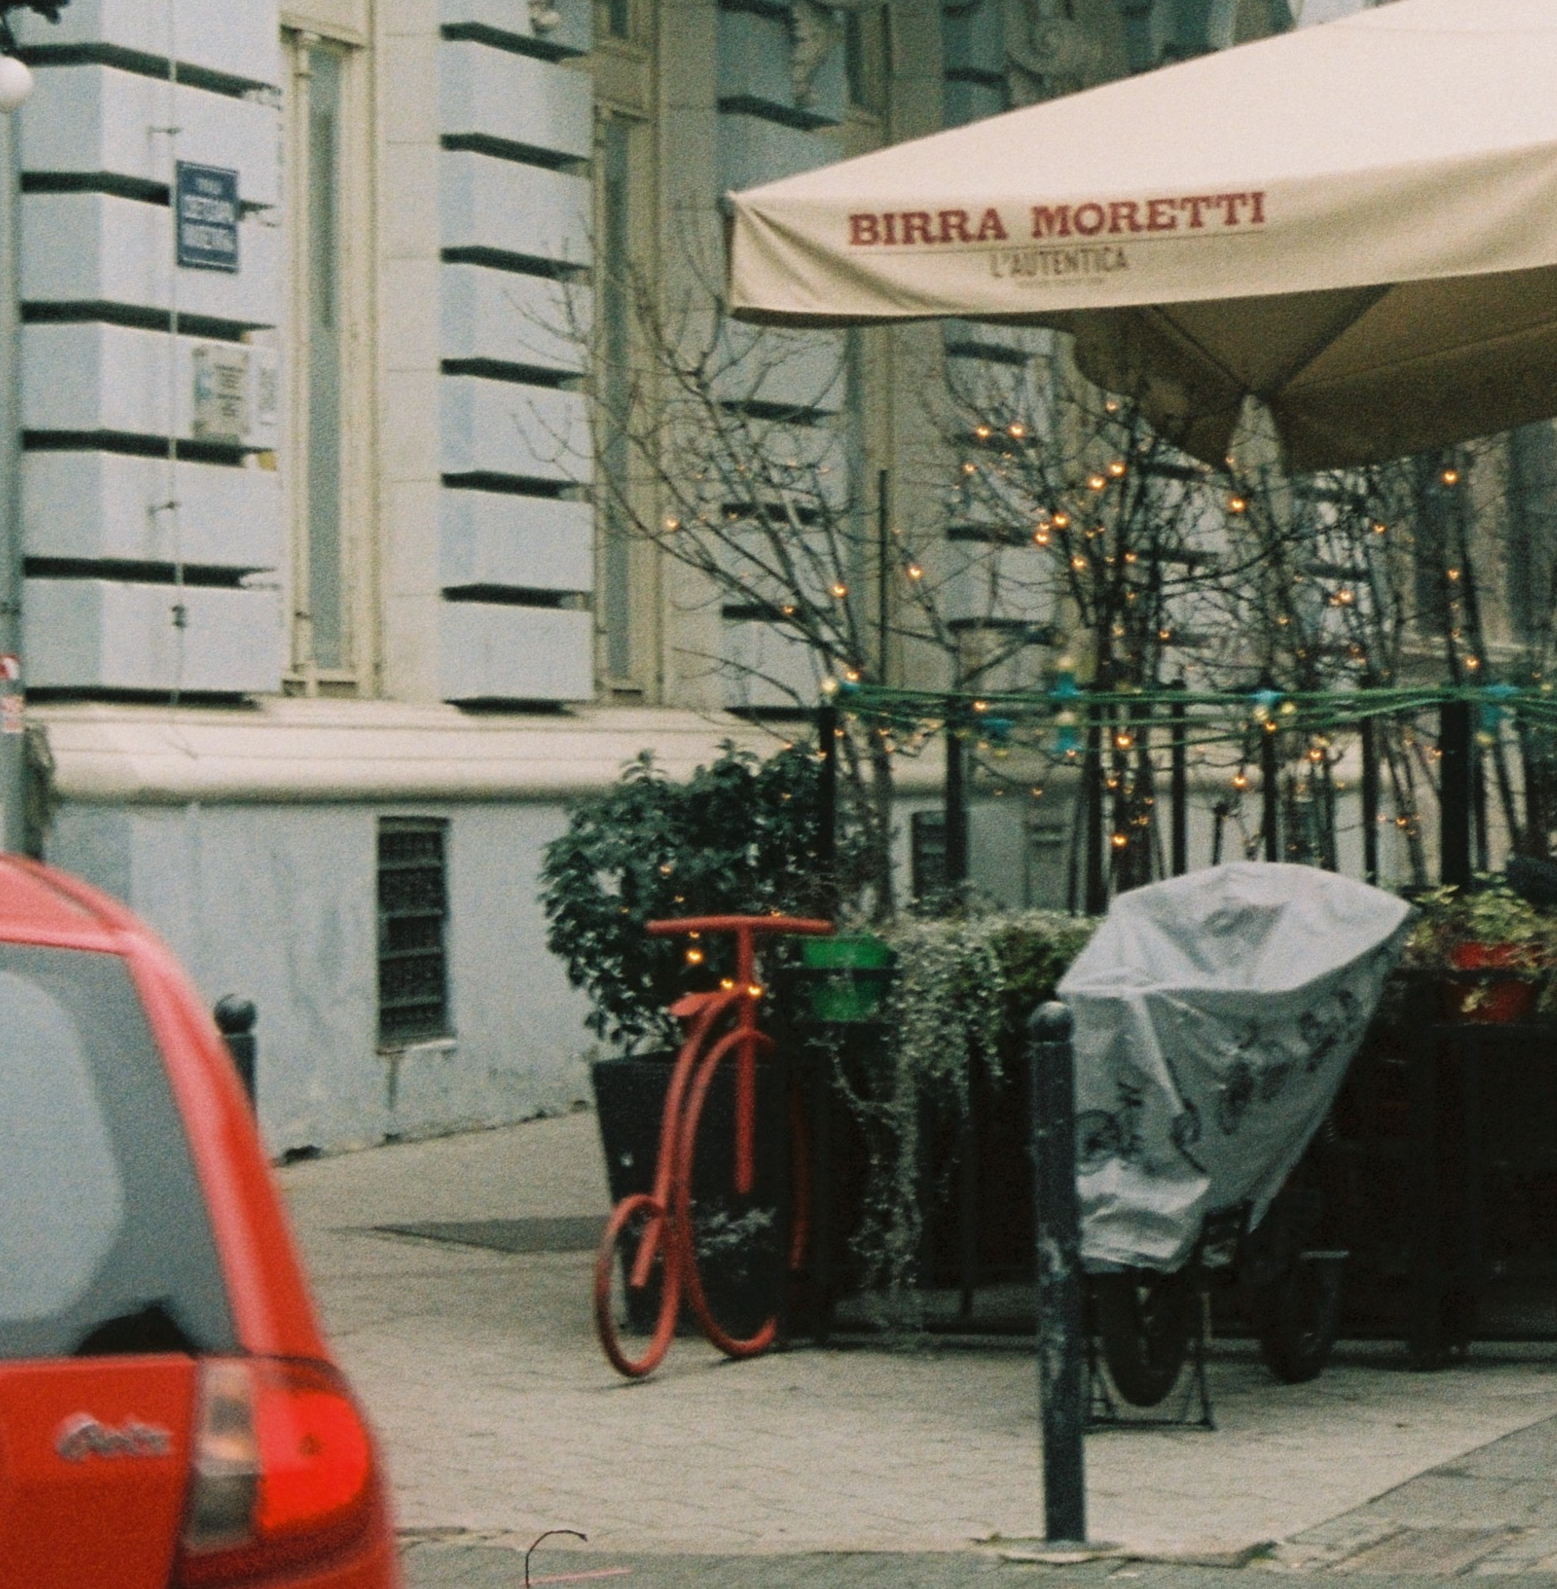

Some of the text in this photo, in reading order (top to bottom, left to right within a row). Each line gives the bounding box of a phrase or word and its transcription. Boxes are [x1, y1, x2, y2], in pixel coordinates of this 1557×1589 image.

[848, 190, 1266, 247] BIRRA MORETTI
[988, 245, 1129, 279] L'AUTENTICA
